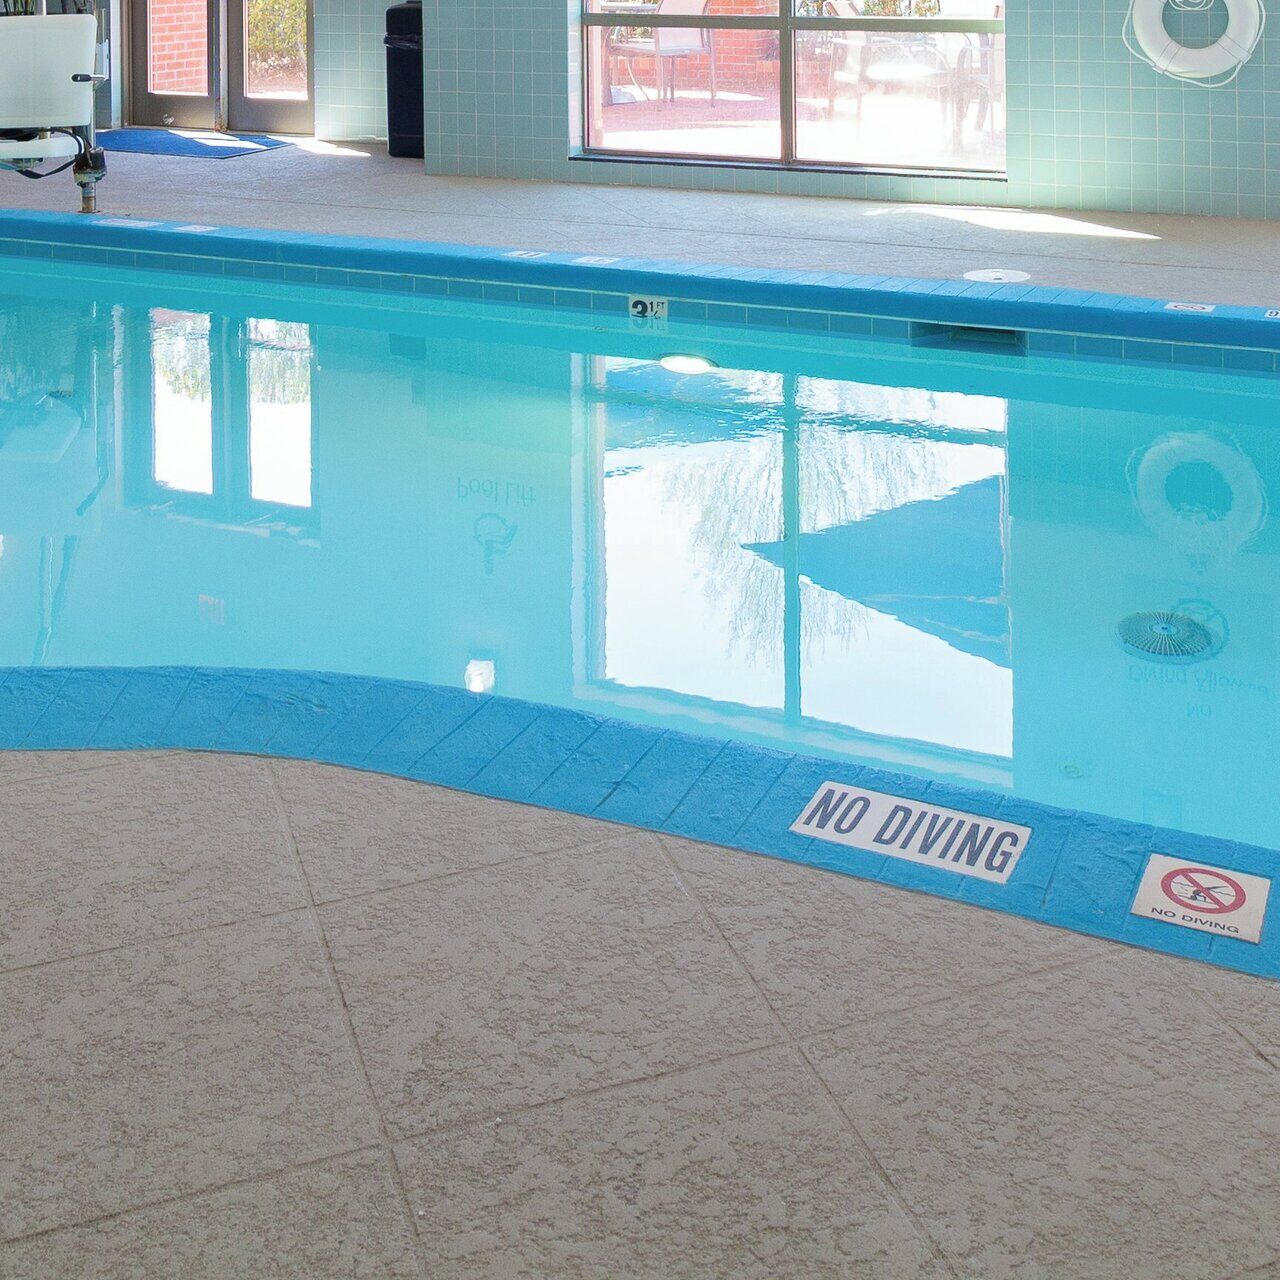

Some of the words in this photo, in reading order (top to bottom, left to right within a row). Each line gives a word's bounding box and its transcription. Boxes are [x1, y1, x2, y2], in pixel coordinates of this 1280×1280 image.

[803, 788, 871, 834] NO
[872, 804, 1019, 873] DIVING
[1151, 907, 1176, 918] NO
[1181, 914, 1239, 933] DIVING
